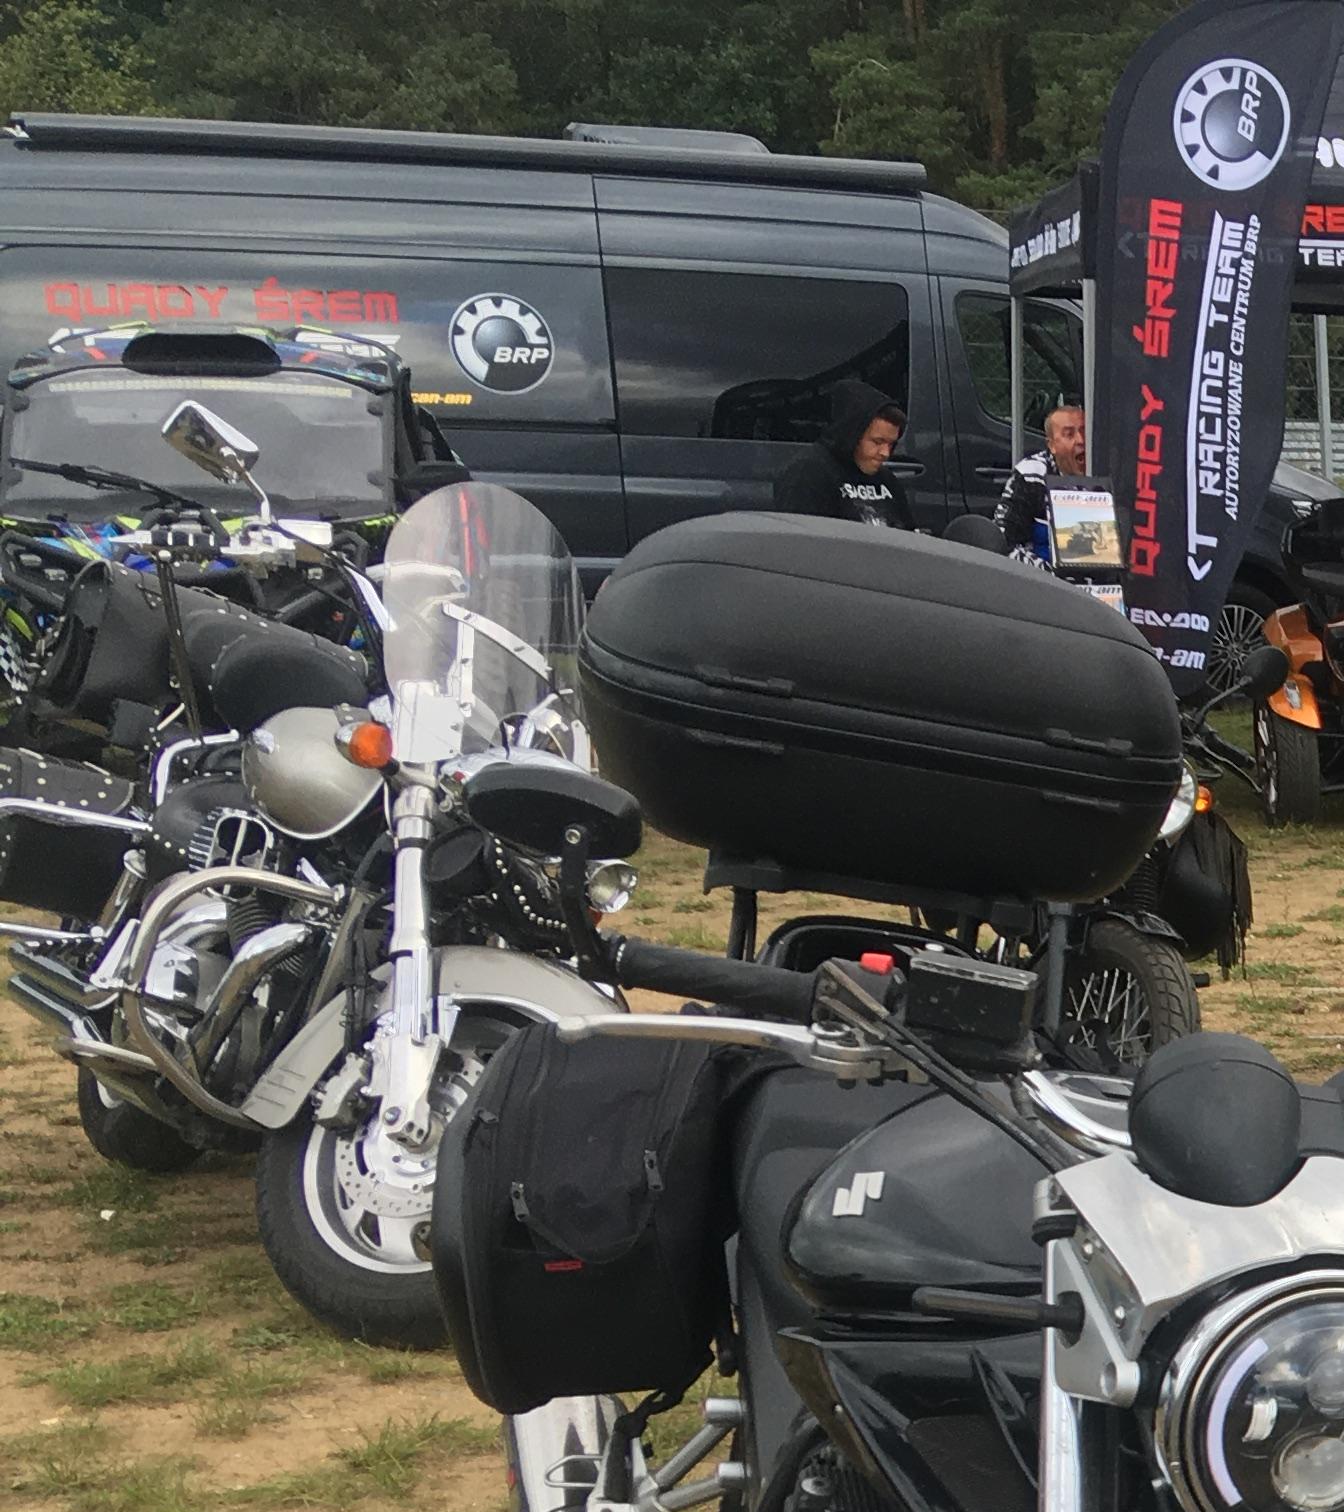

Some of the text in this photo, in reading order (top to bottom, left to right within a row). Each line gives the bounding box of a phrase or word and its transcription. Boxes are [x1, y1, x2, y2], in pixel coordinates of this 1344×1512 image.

[1236, 69, 1262, 142] BRP
[44, 276, 400, 324] QUADY ŚREM
[1208, 220, 1245, 328] TEAM
[492, 345, 550, 364] BRP
[1130, 199, 1182, 577] QUADY ŚREM
[1224, 214, 1261, 521] AUTORYZOWANE CENTRUM BRP
[1198, 350, 1230, 498] RACING
